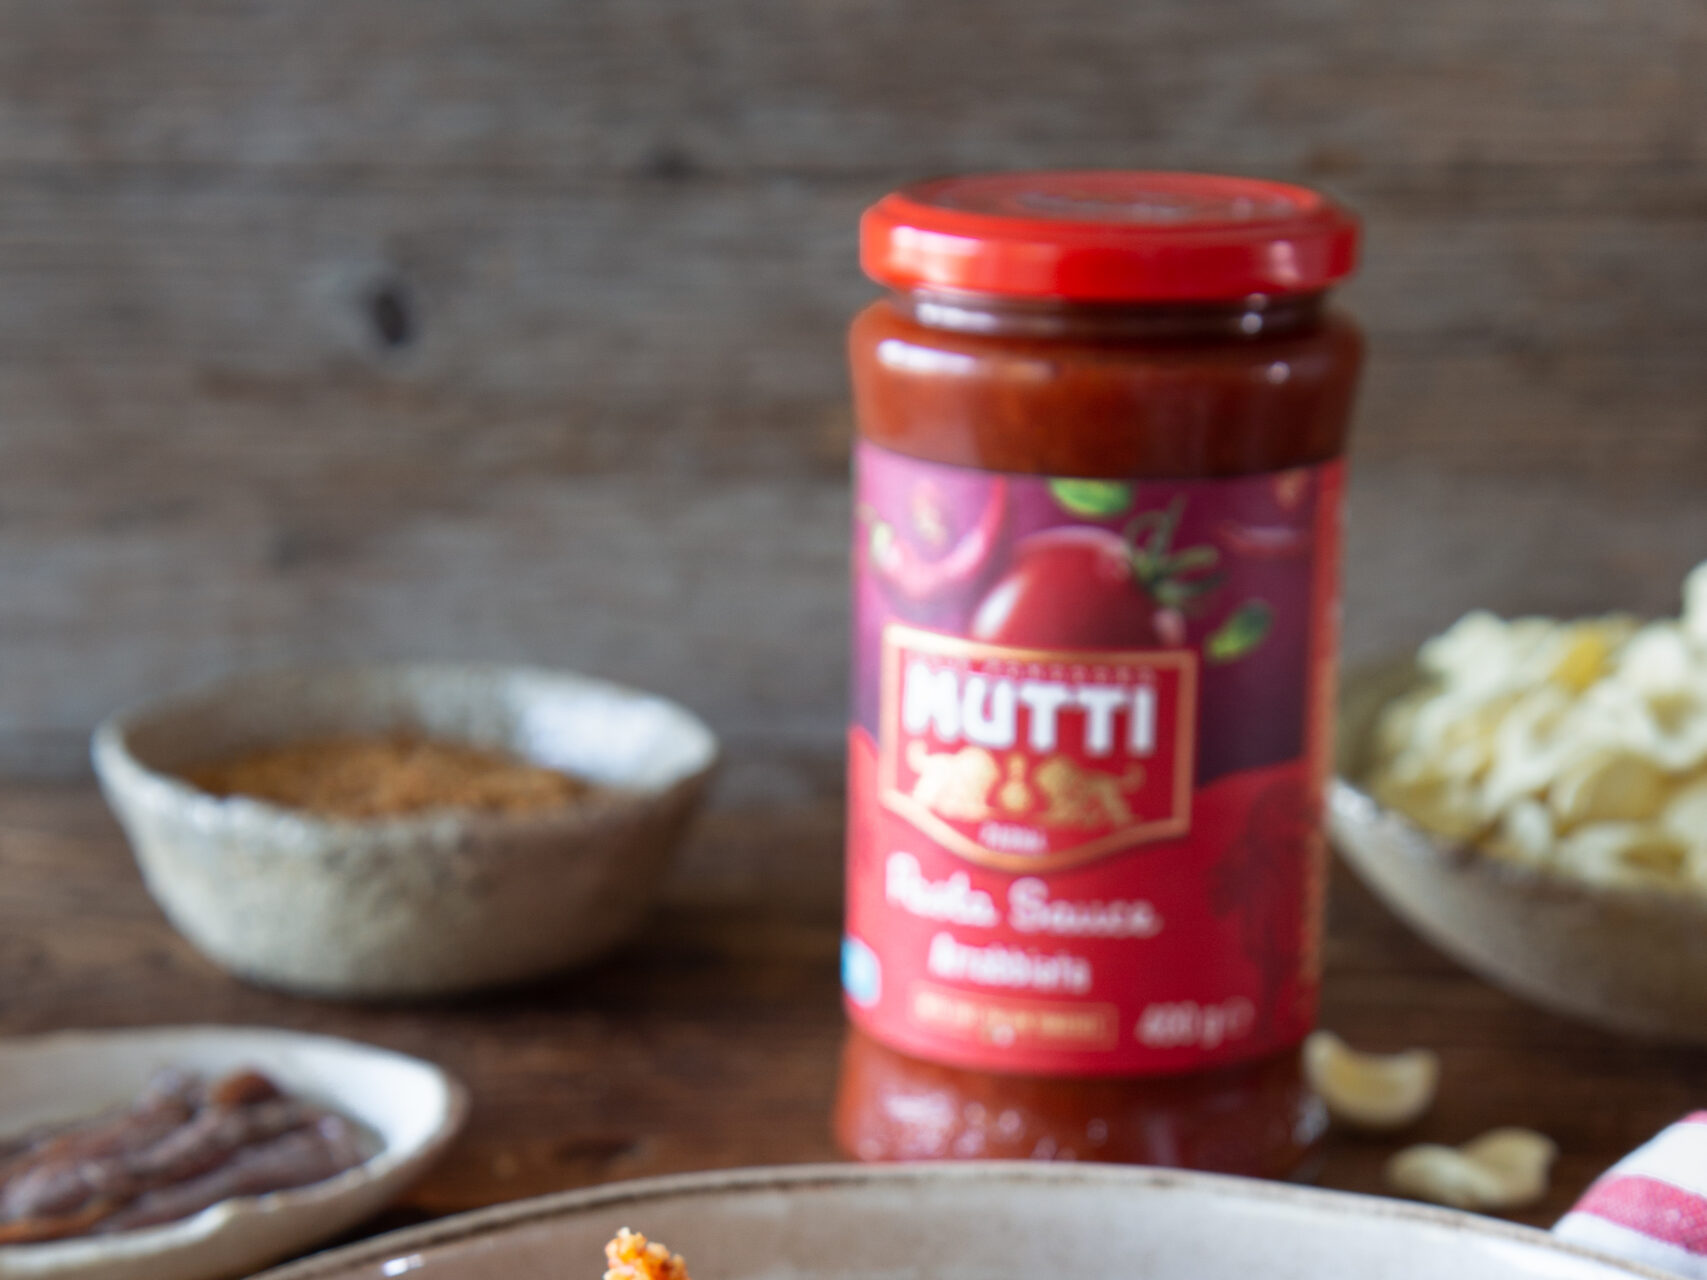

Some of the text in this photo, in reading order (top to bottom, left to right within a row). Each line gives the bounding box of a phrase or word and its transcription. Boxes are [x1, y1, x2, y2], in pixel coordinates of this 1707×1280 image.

[904, 664, 1153, 755] MUTTI
[887, 855, 1160, 935] Pasta Sauce
